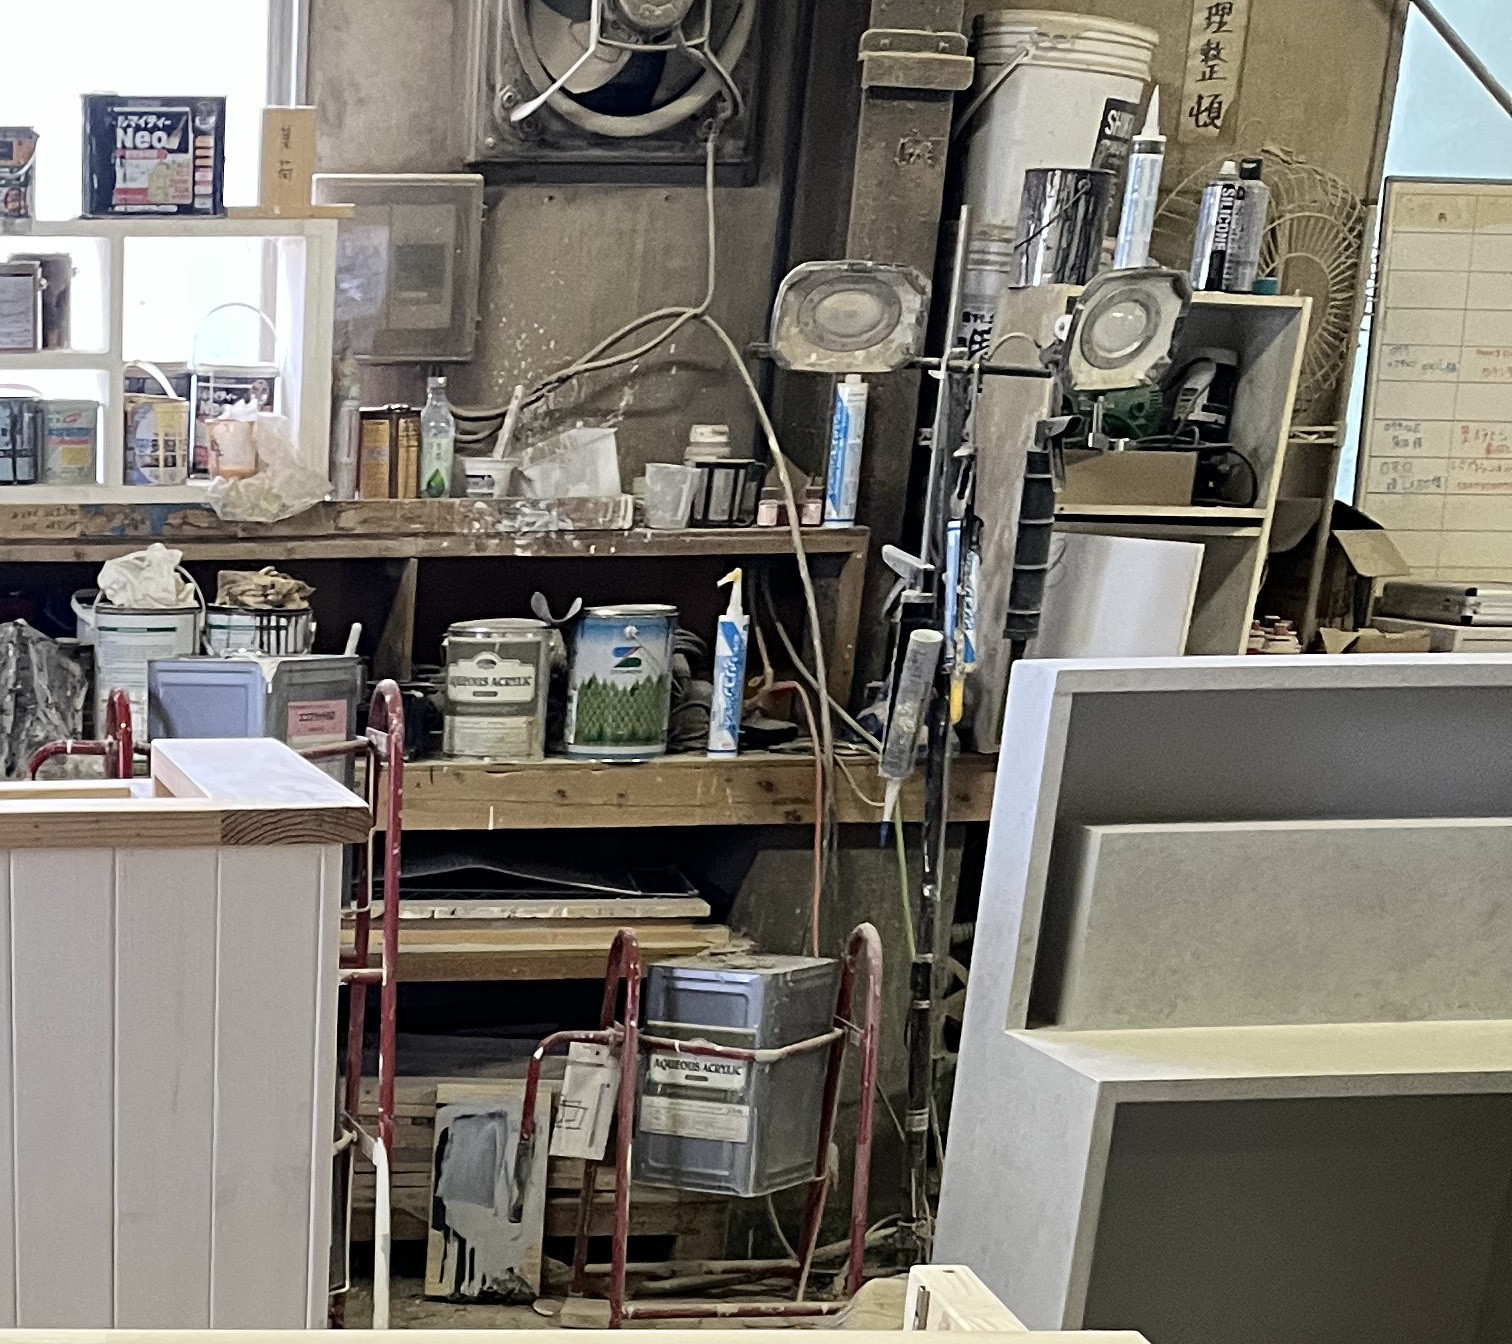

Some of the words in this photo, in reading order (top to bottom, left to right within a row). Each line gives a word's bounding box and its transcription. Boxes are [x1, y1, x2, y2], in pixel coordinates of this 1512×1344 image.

[116, 128, 168, 149] Neo
[653, 1058, 700, 1071] AQUEOUS
[703, 1063, 743, 1076] ACRYLIC
